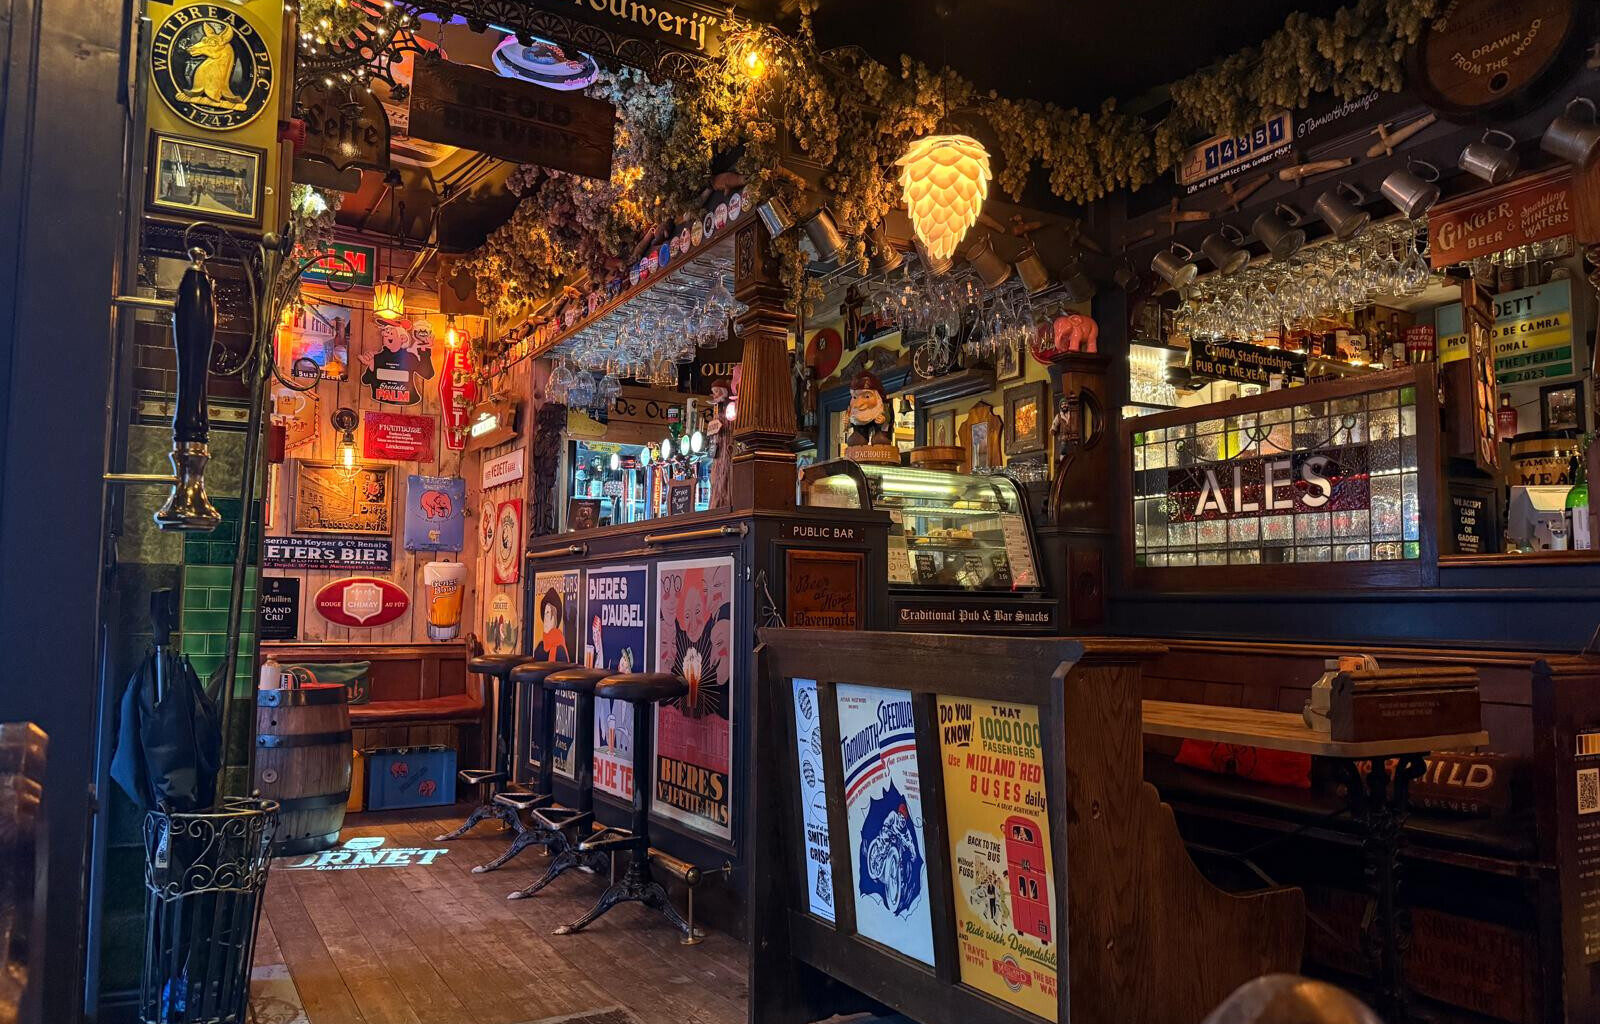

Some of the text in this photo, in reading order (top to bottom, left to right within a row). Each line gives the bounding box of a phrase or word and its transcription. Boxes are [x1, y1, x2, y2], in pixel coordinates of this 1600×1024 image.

[154, 6, 270, 91] WHITBREAD PLC
[1450, 52, 1481, 75] FROM
[1486, 57, 1509, 73] THE
[1512, 18, 1542, 56] WOOD
[1471, 32, 1520, 59] DRAWN
[189, 109, 235, 126] 1742
[1208, 123, 1280, 164] 14351
[1521, 202, 1569, 228] MINERAL
[1437, 202, 1514, 251] GINGER
[1525, 213, 1569, 238] WATERS
[1468, 231, 1503, 249] BEER
[1503, 327, 1516, 336] BE
[1520, 317, 1560, 332] CAMRA
[1205, 344, 1292, 369] CAMRA Staffordshire
[1196, 360, 1213, 373] PUB
[1215, 363, 1227, 375] OF
[1229, 365, 1244, 378] THE
[1246, 368, 1269, 382] YEAR
[375, 388, 410, 402] PALM
[616, 400, 637, 417] De
[1194, 456, 1333, 516] ALES
[1460, 508, 1475, 516] CASH
[1460, 516, 1476, 525] CARD
[793, 526, 854, 539] PUBLIC BAR
[1457, 533, 1479, 543] GADGET
[1464, 526, 1472, 534] OR
[304, 539, 336, 548] Keyser
[266, 545, 389, 562] ETER'S BIER
[589, 577, 628, 600] BIERES
[265, 613, 284, 621] CRU
[601, 604, 644, 627] D'AUBEL
[795, 611, 855, 627] Davenports
[900, 608, 1049, 624] Traditional Pub & Bar Snacks
[877, 699, 914, 735] SPEEDWA
[940, 703, 972, 725] DO YOU
[992, 706, 1021, 719] THAT
[944, 721, 975, 746] KNOW!
[841, 722, 880, 773] TAMWORTH
[982, 740, 1035, 759] PASSENGERS
[947, 754, 961, 767] Use
[966, 753, 1015, 779] MIDLAND
[660, 757, 724, 801] BIÈRES
[970, 774, 1021, 802] BUSES
[1025, 789, 1046, 812] daily
[808, 829, 829, 847] SMITH
[967, 835, 1001, 853] BACK TO THE
[810, 847, 829, 865] CRISP
[987, 851, 1001, 864] BUS
[959, 866, 974, 879] FUSS
[959, 933, 968, 941] AND
[966, 921, 1057, 966] Ride with Dependabili
[962, 941, 990, 961] TRAVEL
[965, 953, 984, 968] WITH
[1033, 970, 1044, 982] THE
